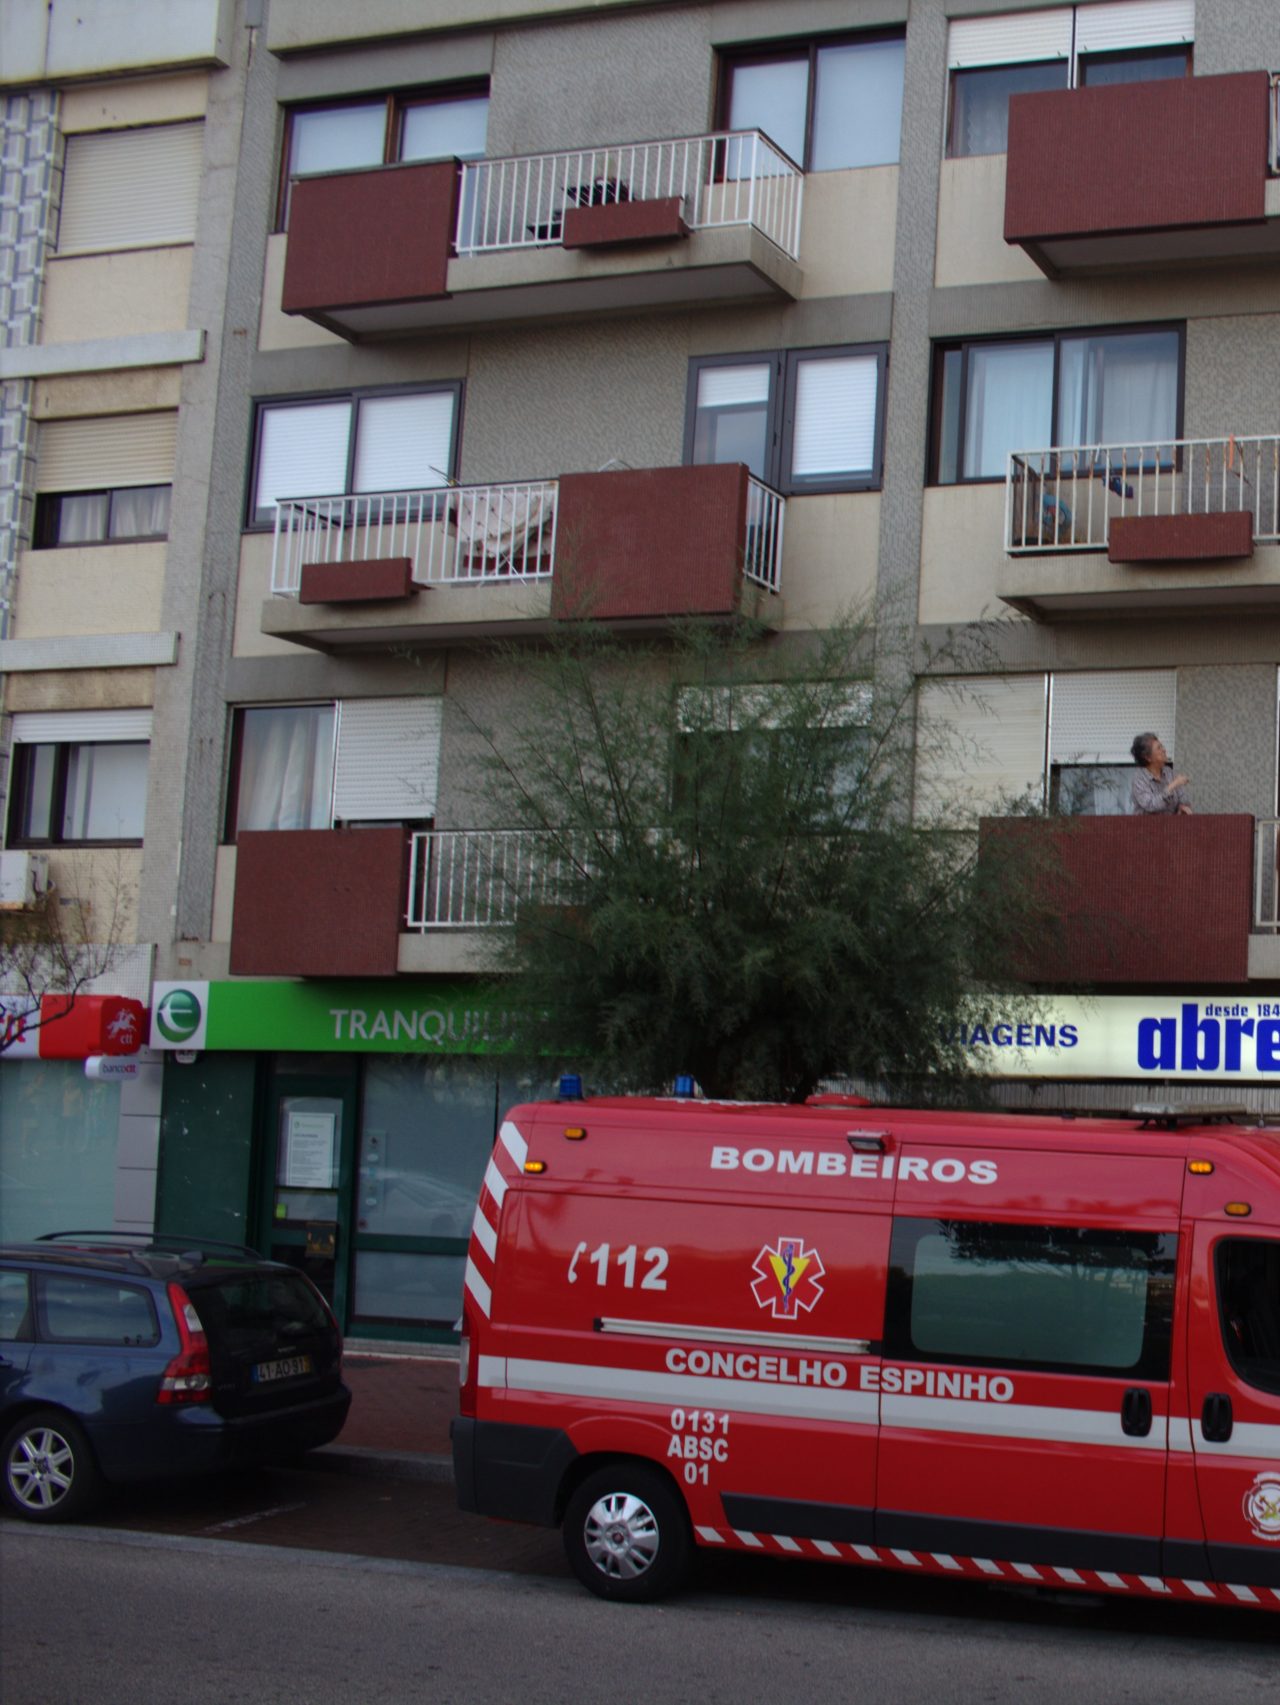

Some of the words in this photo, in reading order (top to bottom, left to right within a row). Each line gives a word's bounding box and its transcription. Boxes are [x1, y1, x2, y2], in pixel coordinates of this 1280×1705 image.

[1205, 1003, 1249, 1017] desde
[710, 1146, 998, 1185] BOMBEIROS
[590, 1243, 669, 1291] 112
[665, 1348, 847, 1387] CONCELHO
[860, 1365, 1014, 1402] ESPINHO
[670, 1408, 730, 1434] 0131
[667, 1435, 729, 1462] ABSC
[684, 1462, 709, 1485] 01
